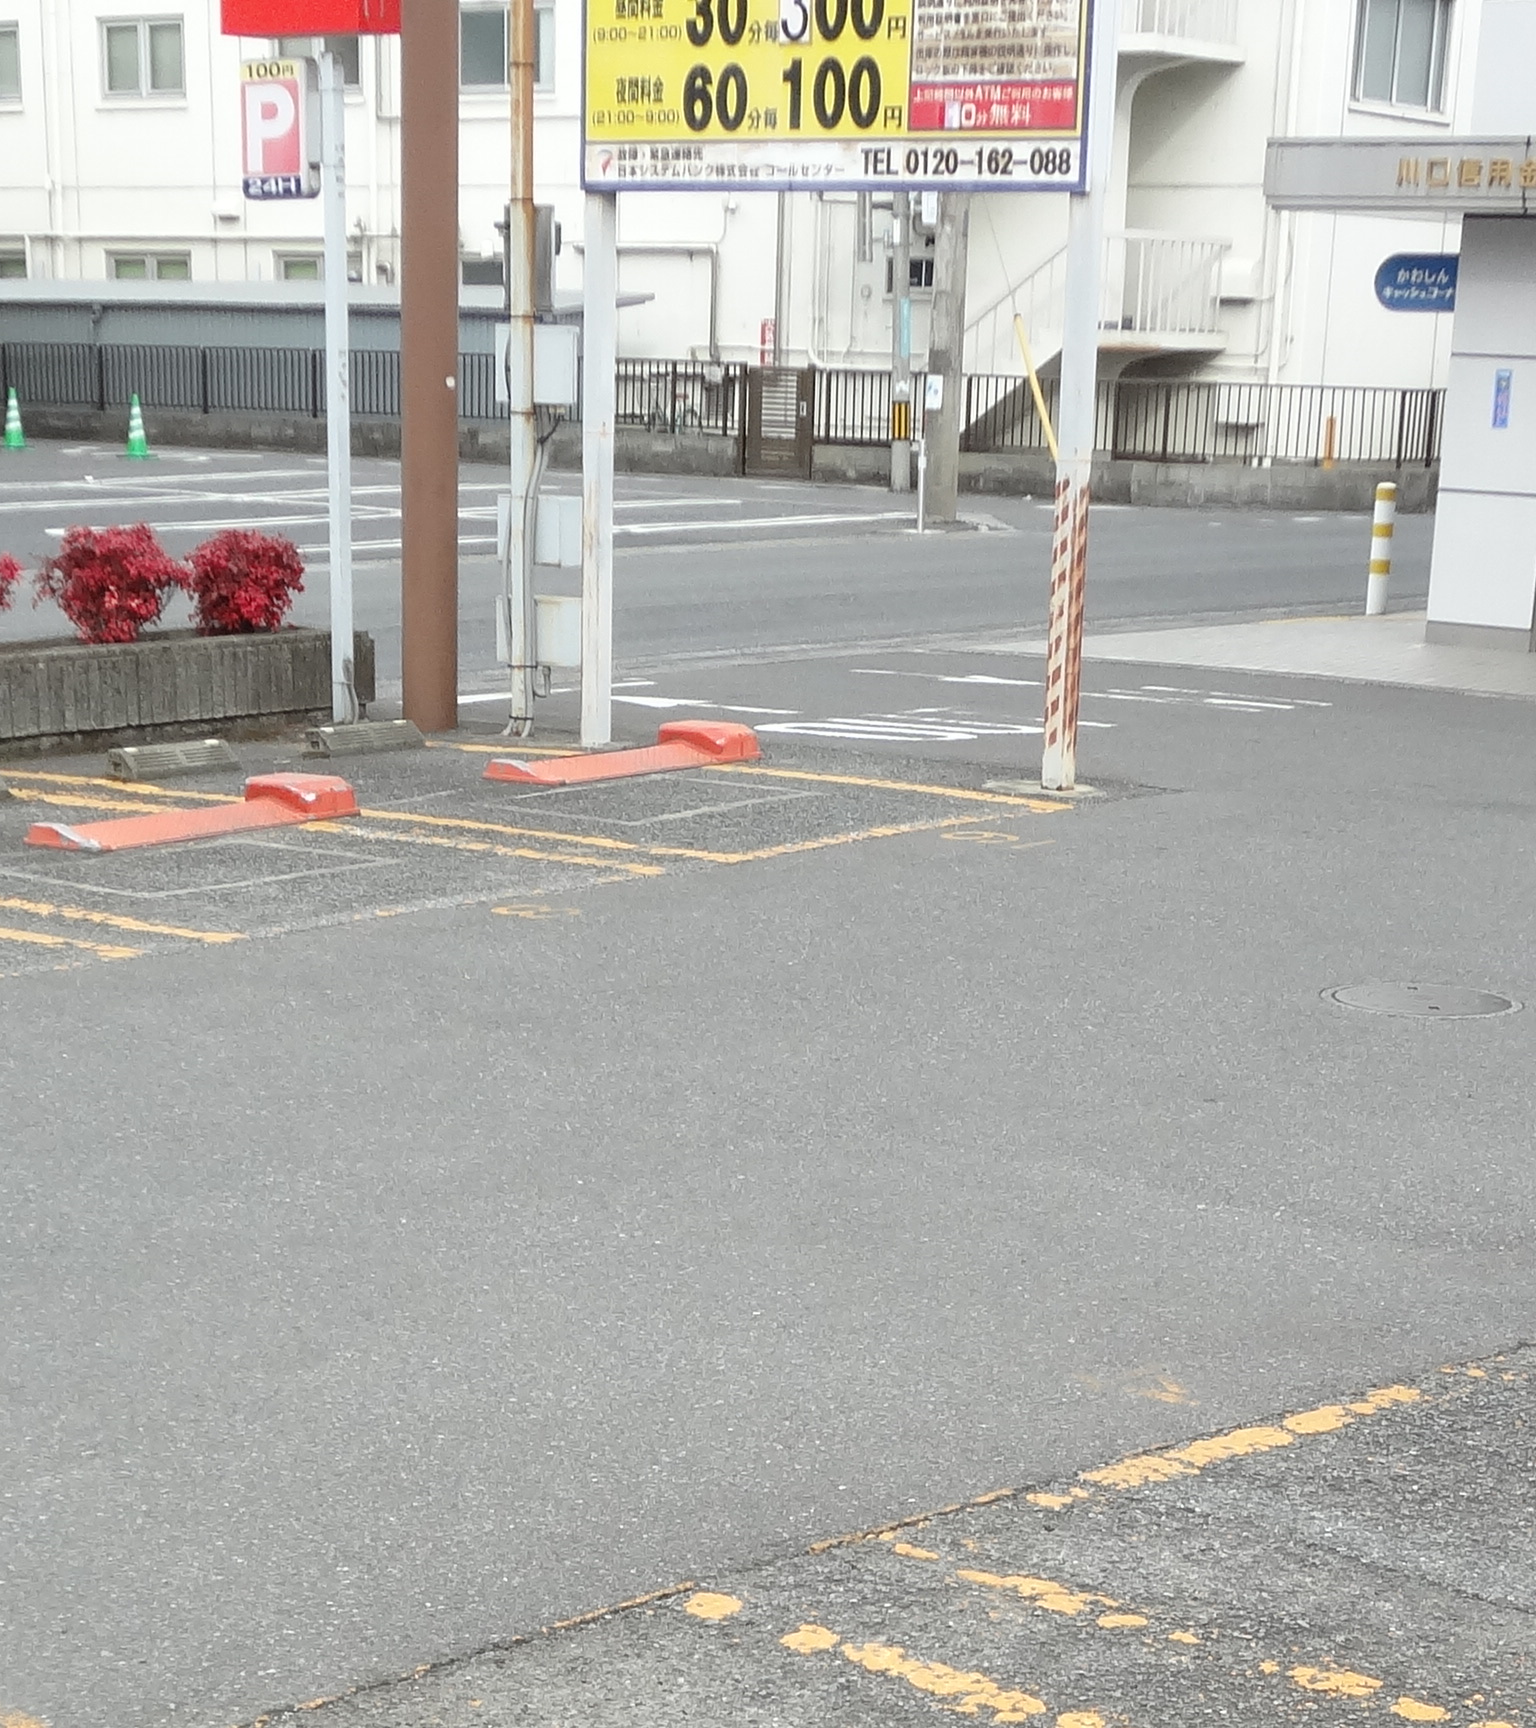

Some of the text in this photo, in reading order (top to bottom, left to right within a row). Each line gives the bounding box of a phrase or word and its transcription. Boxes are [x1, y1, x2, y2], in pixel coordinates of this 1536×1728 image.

[247, 62, 294, 79] 100円
[616, 76, 664, 105] 夜間料金
[245, 83, 295, 175] P
[861, 148, 1072, 176] TEL 0120-162-088
[247, 176, 296, 196] 24H
[1397, 267, 1449, 284] かわしん
